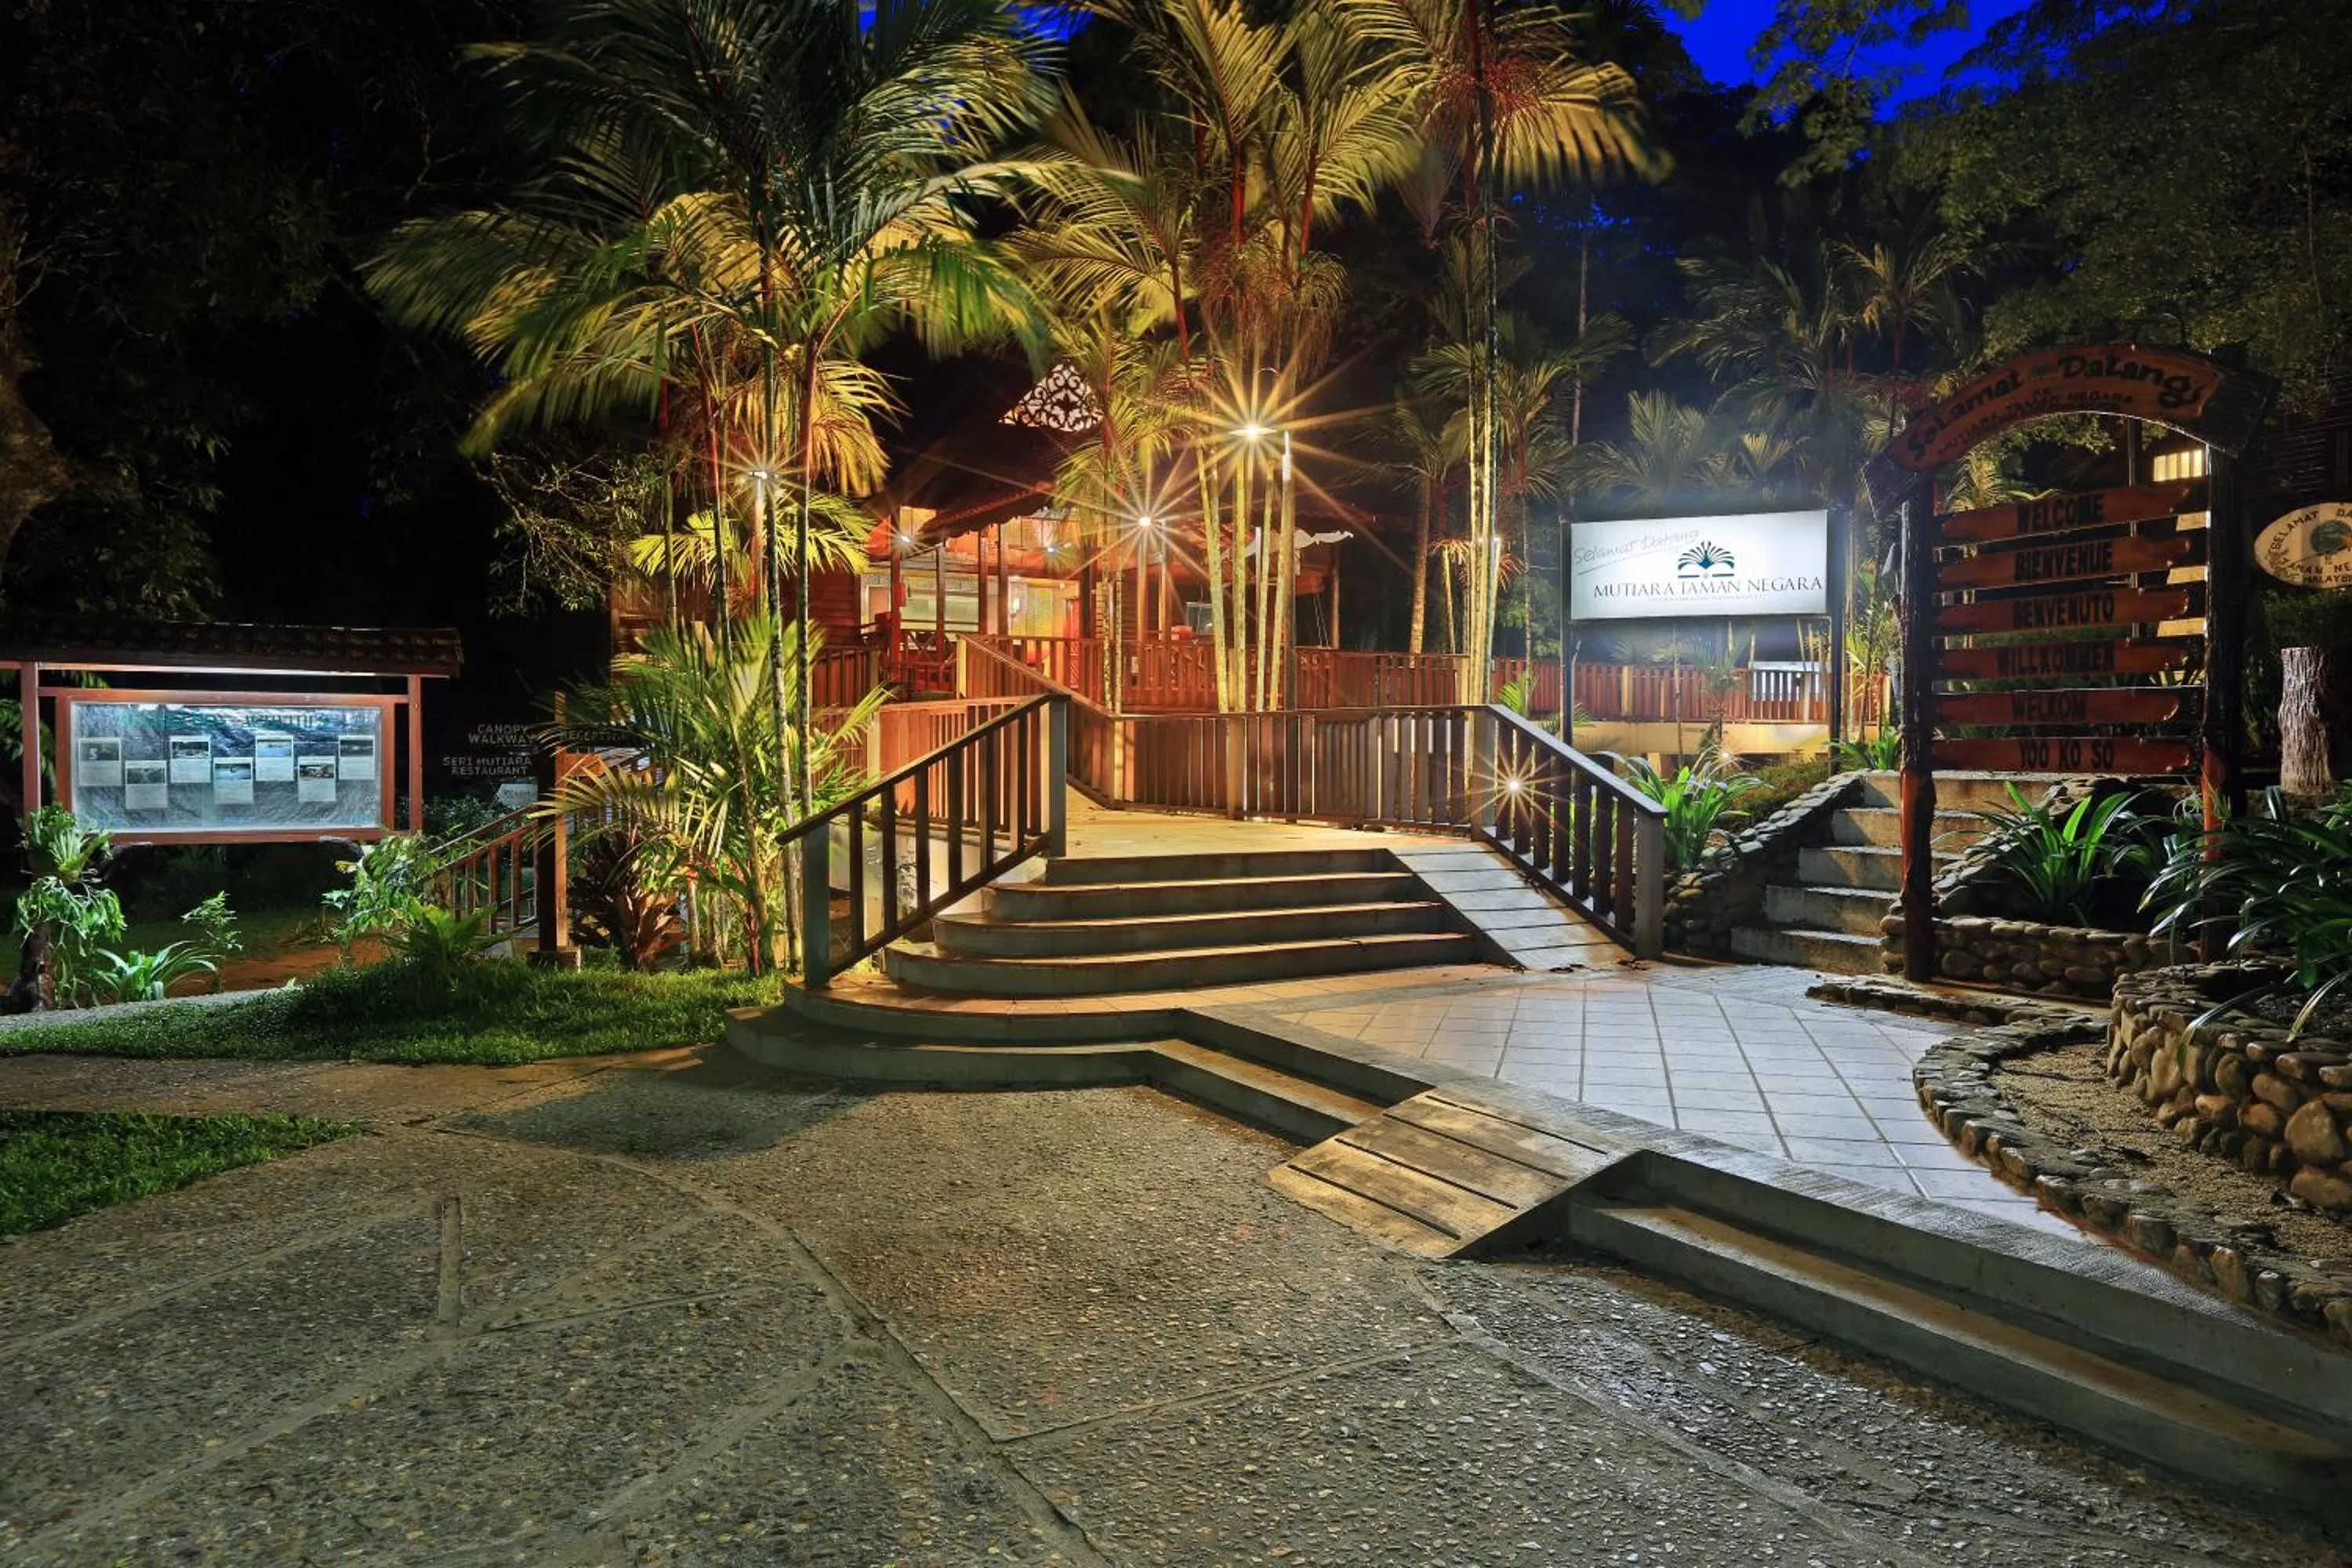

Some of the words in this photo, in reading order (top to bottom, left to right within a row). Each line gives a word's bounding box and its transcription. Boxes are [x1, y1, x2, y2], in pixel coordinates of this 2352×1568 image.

[2017, 494, 2106, 534] WELCOME
[2015, 541, 2113, 580] BIENVENUE
[1594, 583, 1675, 598] MUTIARA
[1676, 579, 1741, 595] TAMAN
[1747, 576, 1823, 593] NEGARA
[2013, 593, 2114, 628] BENVENUTO
[1998, 640, 2114, 673] WILLKOMMEN
[2011, 691, 2086, 719] WELKOM
[467, 732, 535, 745] WALKWAY
[477, 724, 528, 734] CANOPY
[442, 757, 472, 766] SERI
[476, 757, 533, 766] MUTIARA
[452, 766, 528, 775] RESTAURANT
